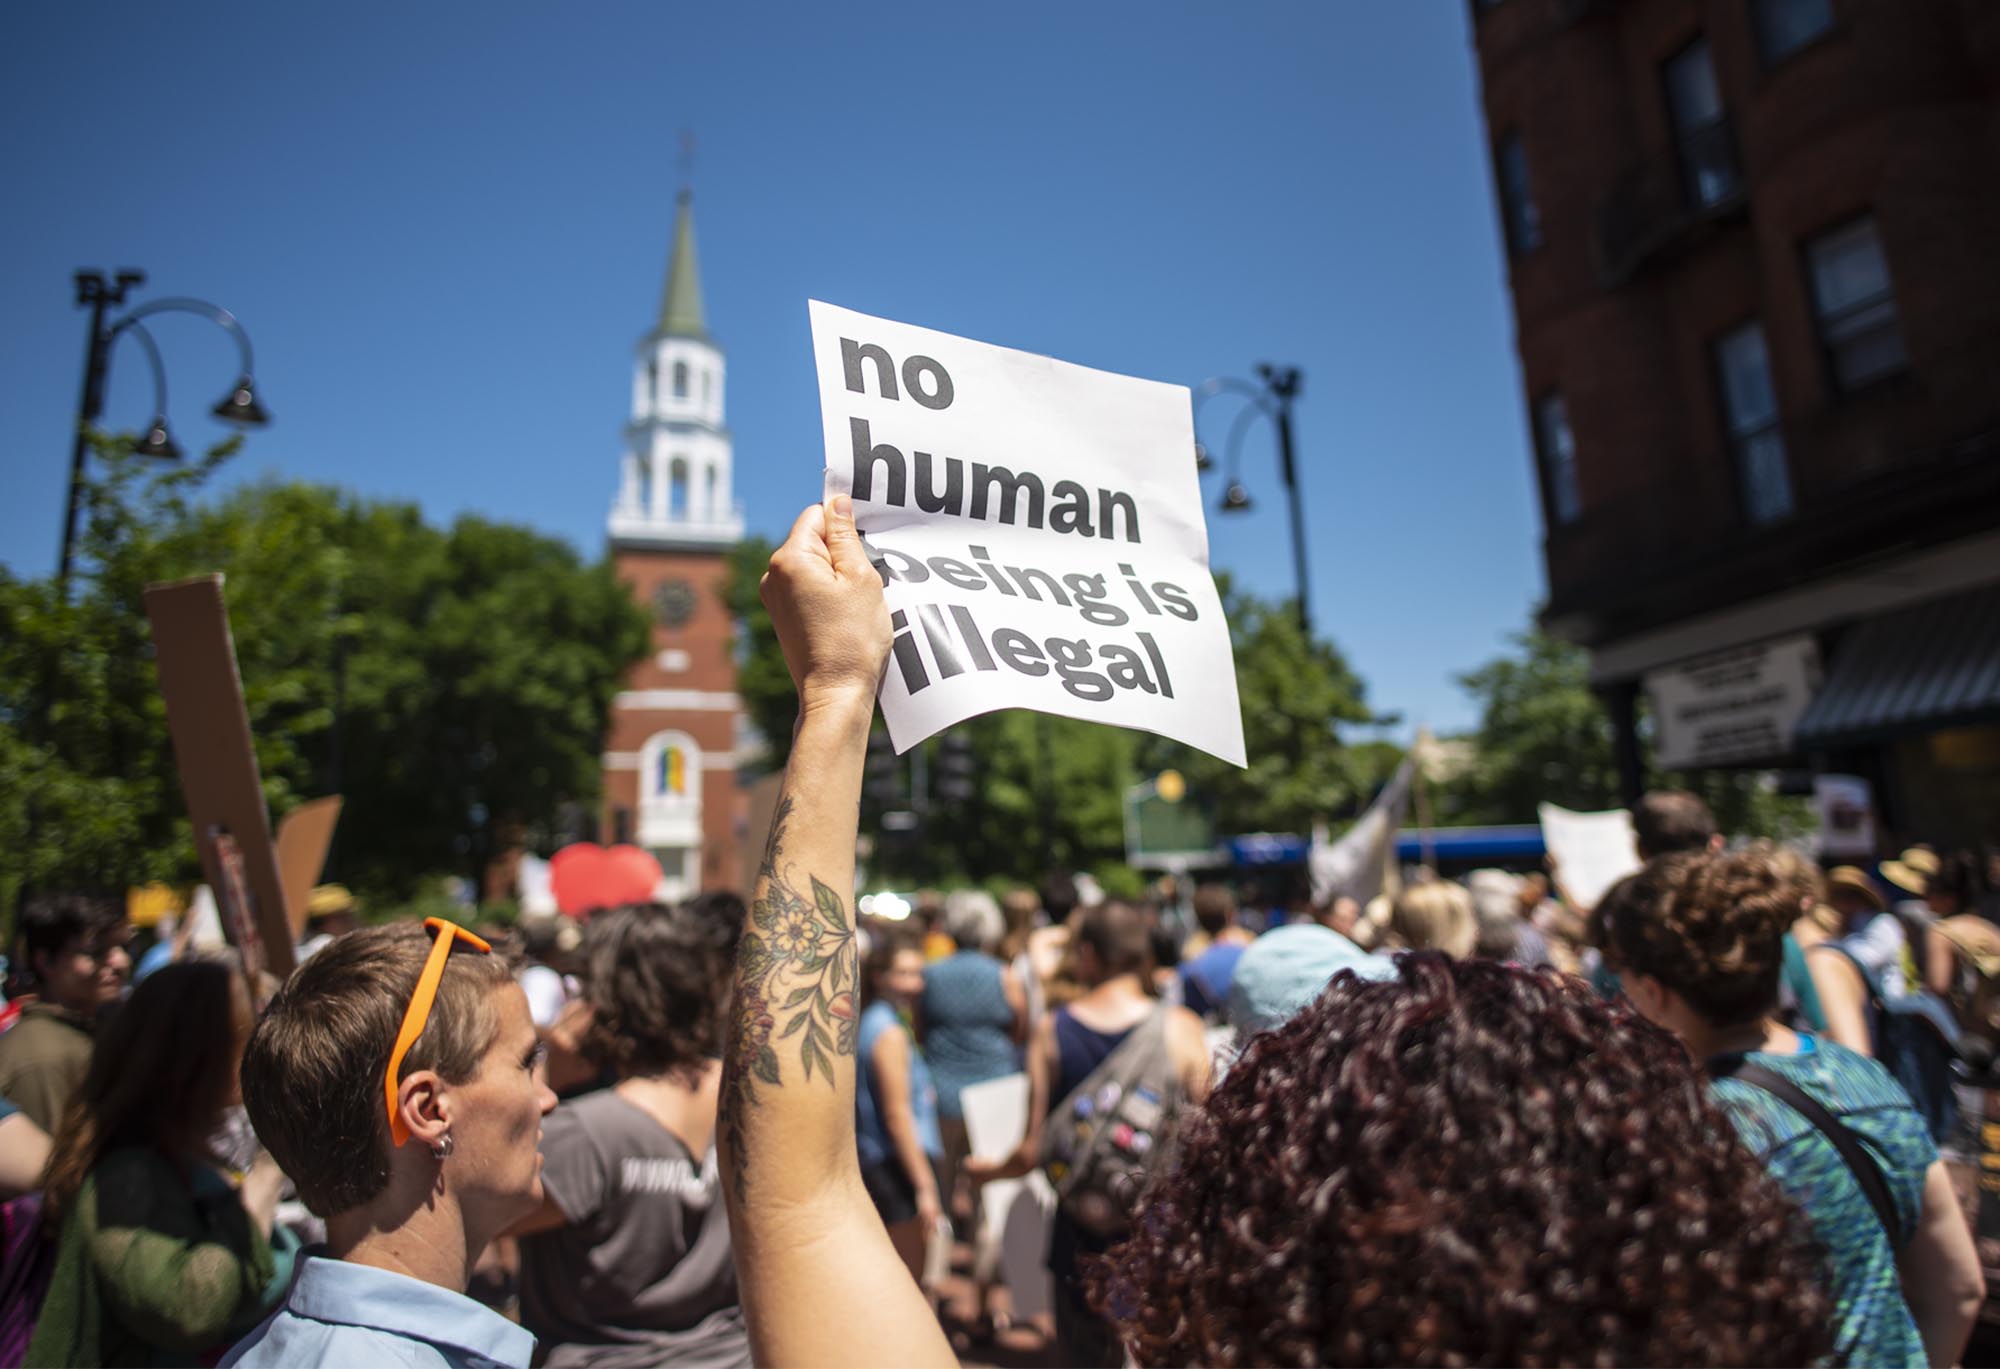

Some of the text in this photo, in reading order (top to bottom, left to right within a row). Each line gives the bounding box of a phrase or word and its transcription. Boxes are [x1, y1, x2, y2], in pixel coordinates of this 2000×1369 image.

[840, 337, 954, 410] no
[849, 416, 1140, 543] human
[858, 529, 1198, 626] being is
[891, 603, 1174, 702] illegal
